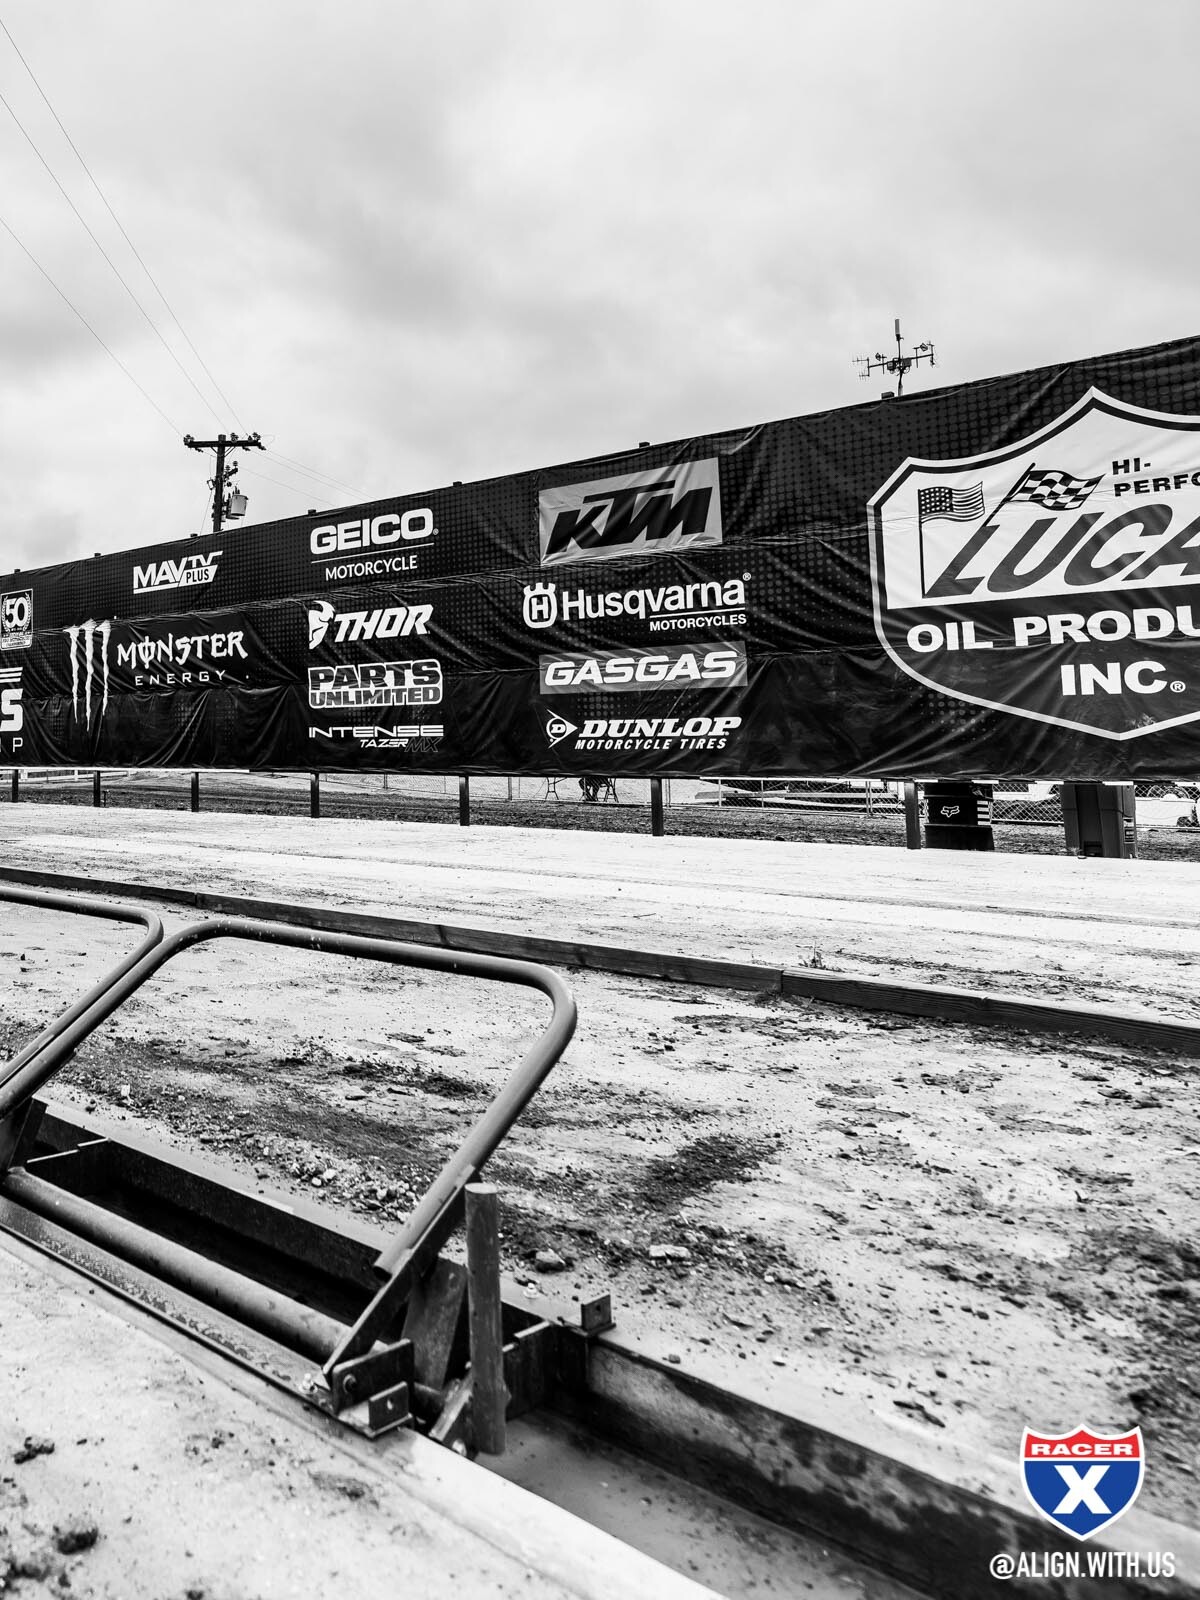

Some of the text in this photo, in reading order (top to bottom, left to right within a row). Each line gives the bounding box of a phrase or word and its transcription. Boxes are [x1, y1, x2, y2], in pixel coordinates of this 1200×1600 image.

[1112, 457, 1151, 475] HI-
[310, 508, 434, 554] GEICO
[549, 480, 713, 554] KTM
[925, 504, 1200, 598] LUCA
[133, 550, 223, 589] MAVTV
[186, 568, 210, 583] PLUS
[325, 555, 418, 581] MOTORCYCLE
[5, 597, 28, 628] 50
[562, 579, 745, 620] Husqvarna
[334, 604, 434, 643] THOR
[649, 613, 747, 632] MOTORCYCLES
[906, 621, 993, 653] OIL
[1013, 605, 1200, 647] PRODU
[117, 631, 248, 669] MONSTER
[135, 670, 225, 686] ENERGY
[308, 659, 442, 689] PARTS
[544, 651, 738, 686] GASGAS
[309, 686, 442, 708] UNLIMITED
[309, 725, 443, 738] INTENSE
[578, 716, 742, 738] DUNLOP
[360, 737, 443, 752] TAZER MX
[574, 737, 727, 750] MOTORCYCLE TIRES
